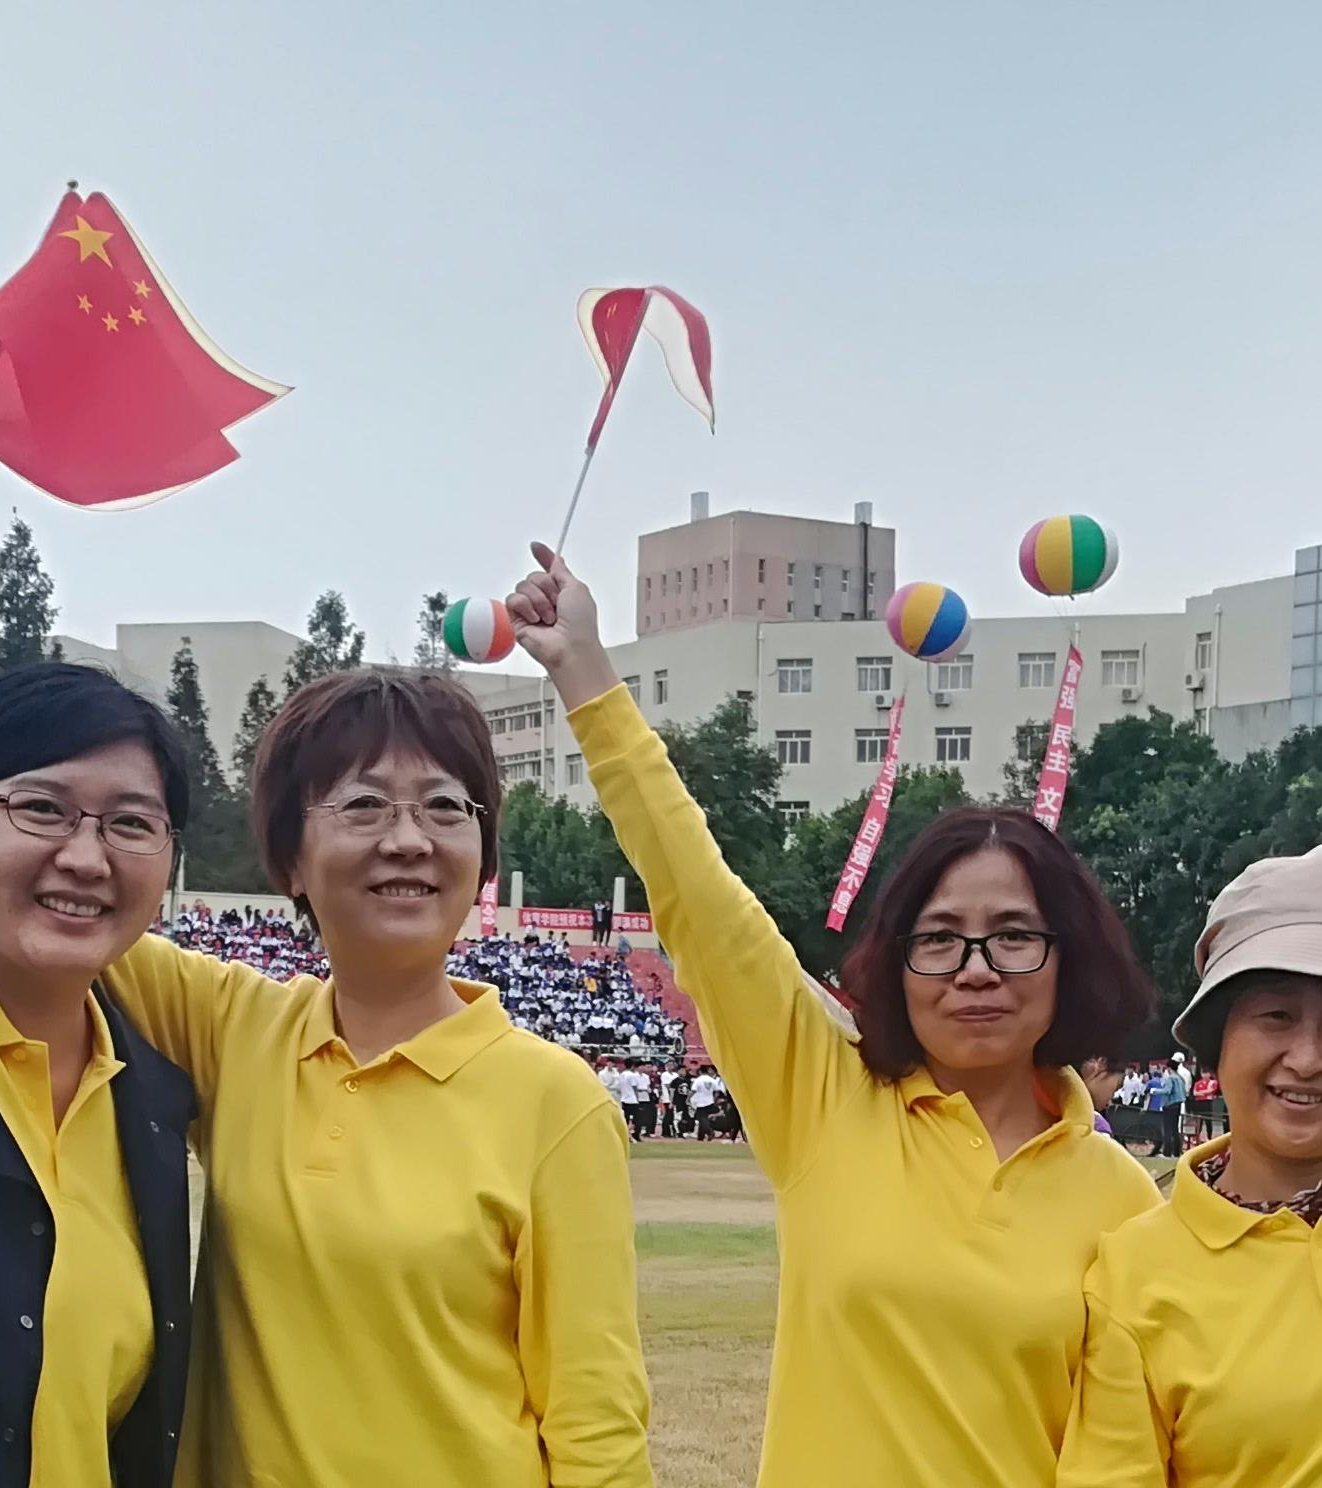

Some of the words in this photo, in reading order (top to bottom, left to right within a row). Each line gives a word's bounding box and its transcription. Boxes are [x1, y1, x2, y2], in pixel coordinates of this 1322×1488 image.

[1059, 659, 1081, 710] 富强
[1045, 723, 1072, 774] 民主
[831, 817, 881, 915] 自强不息
